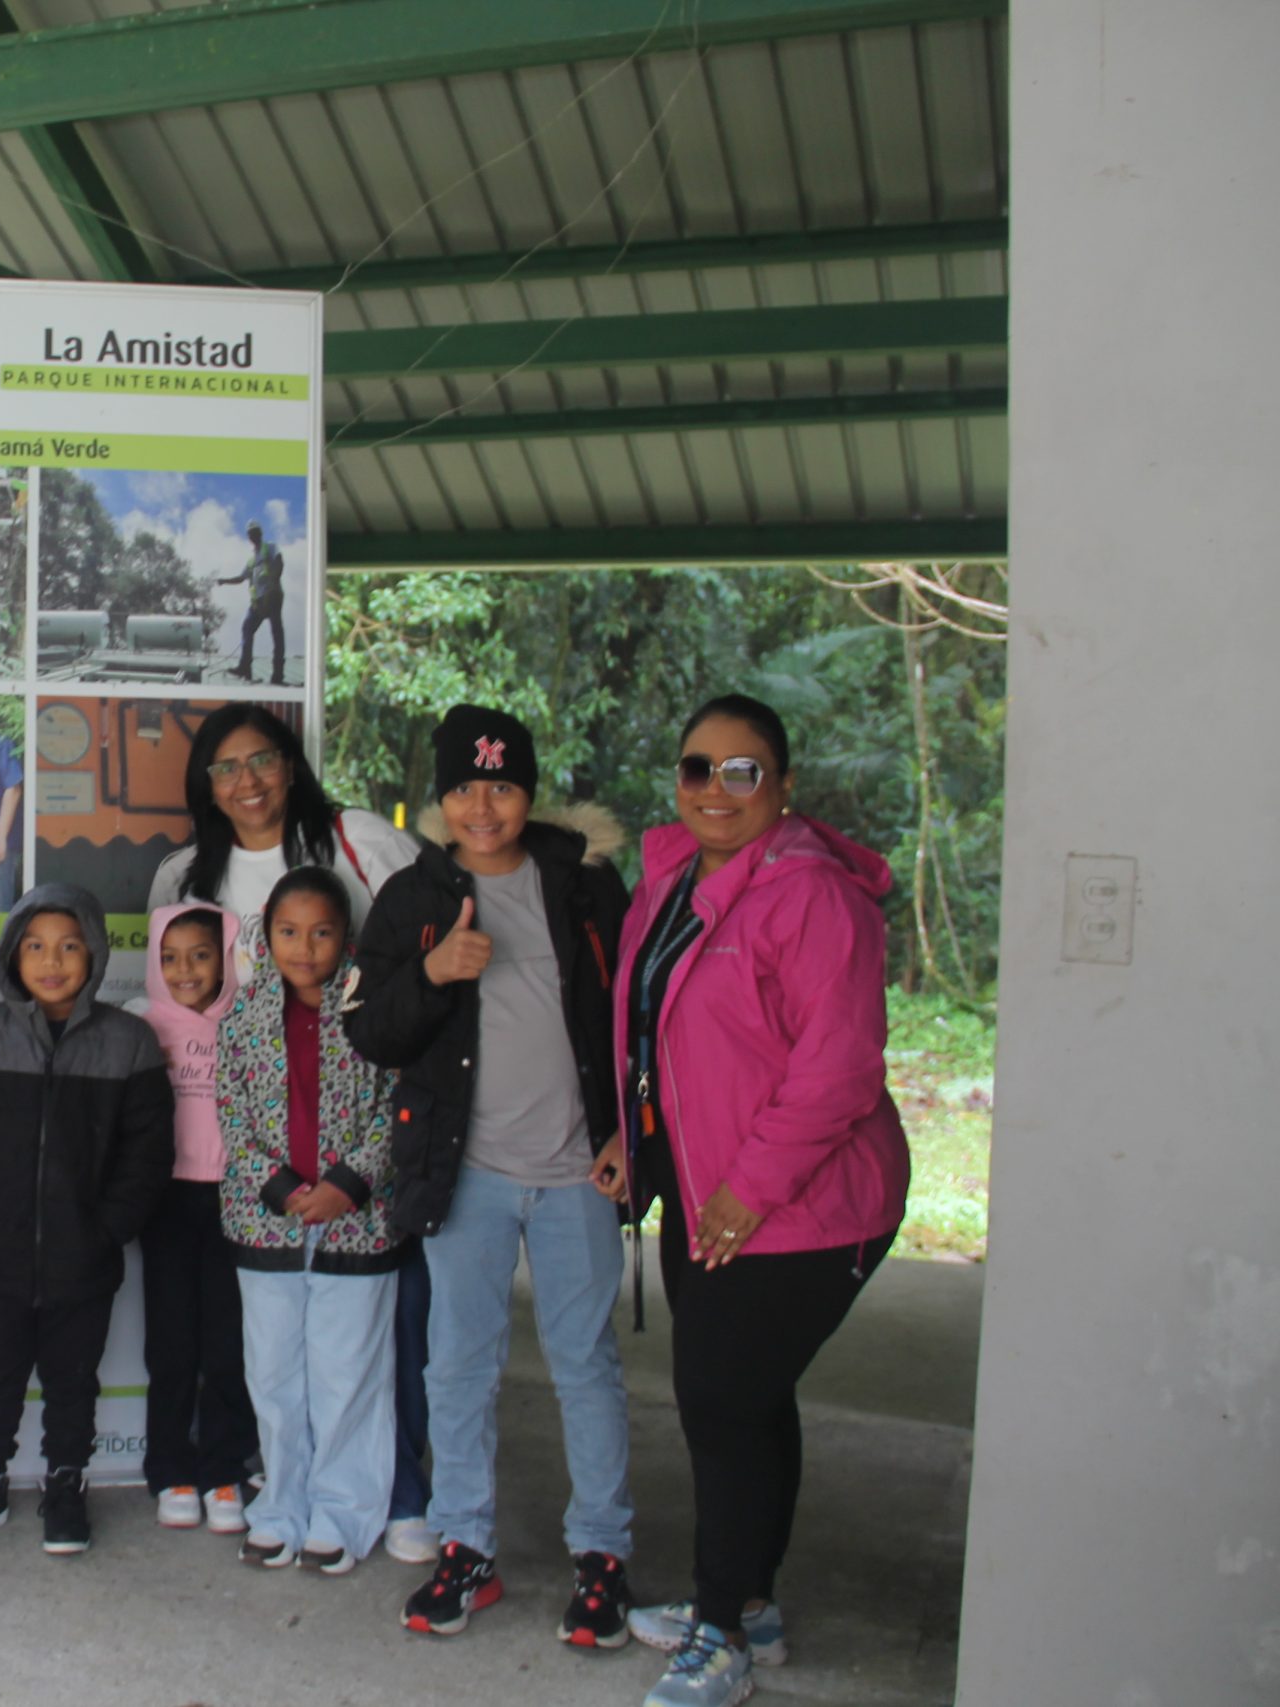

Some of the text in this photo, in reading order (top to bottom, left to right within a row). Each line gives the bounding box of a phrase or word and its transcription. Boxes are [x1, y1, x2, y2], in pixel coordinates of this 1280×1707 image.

[44, 328, 252, 368] La Amistad
[3, 371, 288, 394] PARQUE INTERNACIONAL
[52, 439, 110, 459] Verde
